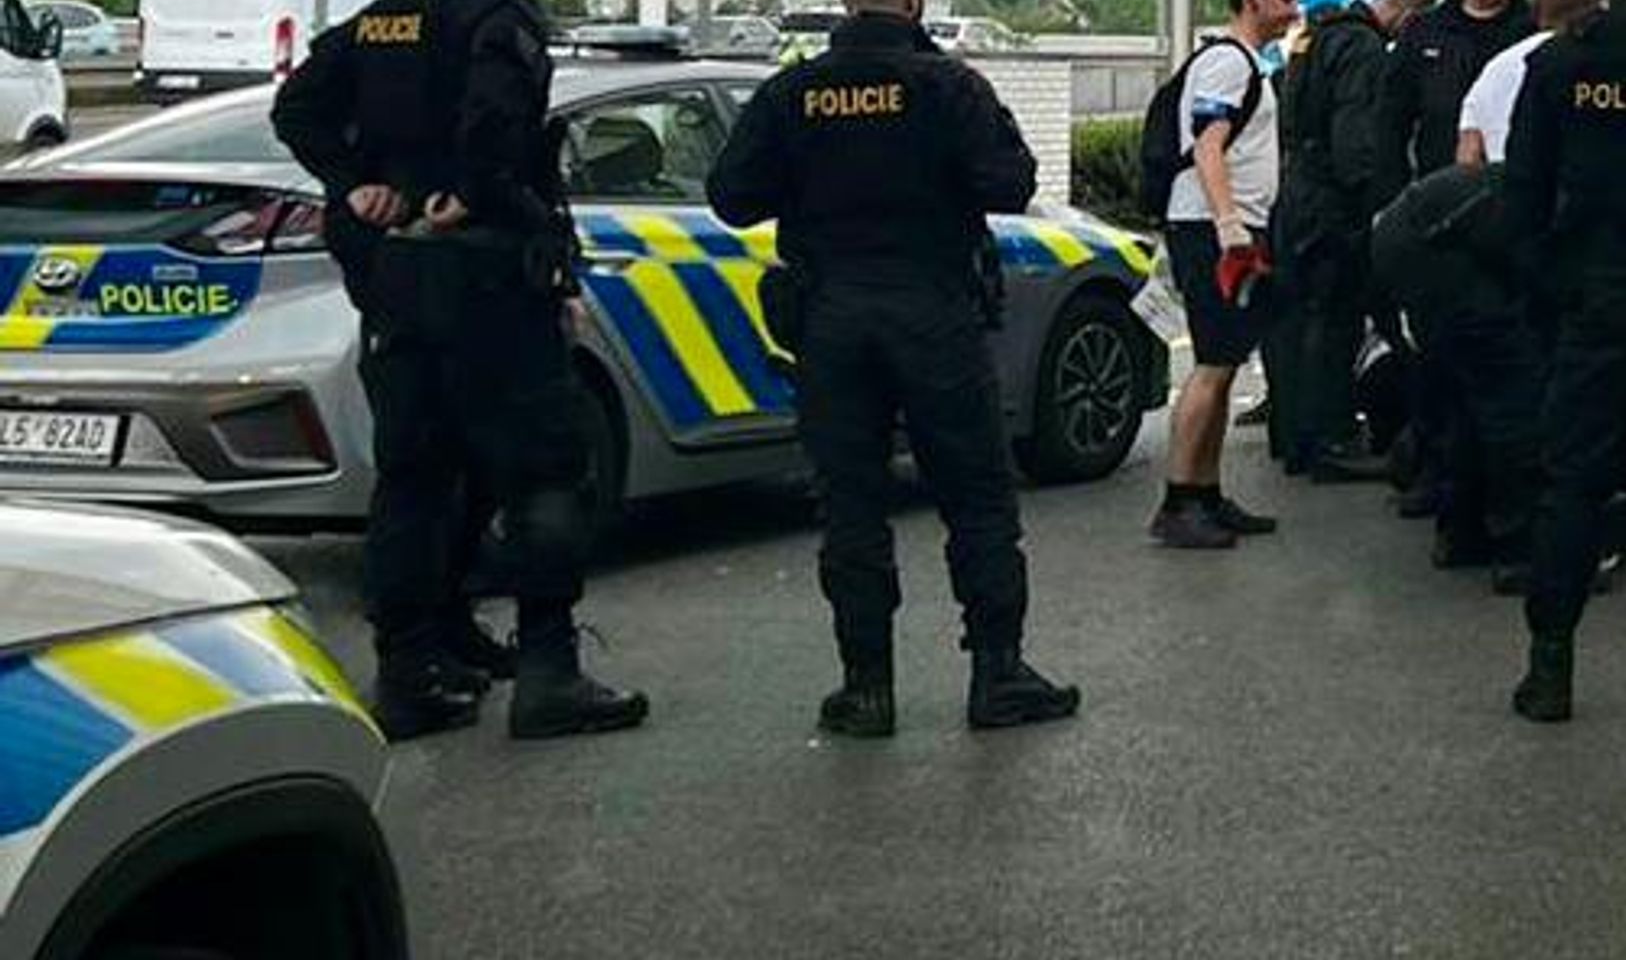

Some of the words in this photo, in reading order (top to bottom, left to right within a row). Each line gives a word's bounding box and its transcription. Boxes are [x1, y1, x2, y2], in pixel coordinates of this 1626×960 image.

[356, 13, 421, 43] POLICIE
[804, 83, 904, 116] POLICIE
[101, 284, 231, 313] POLICIE
